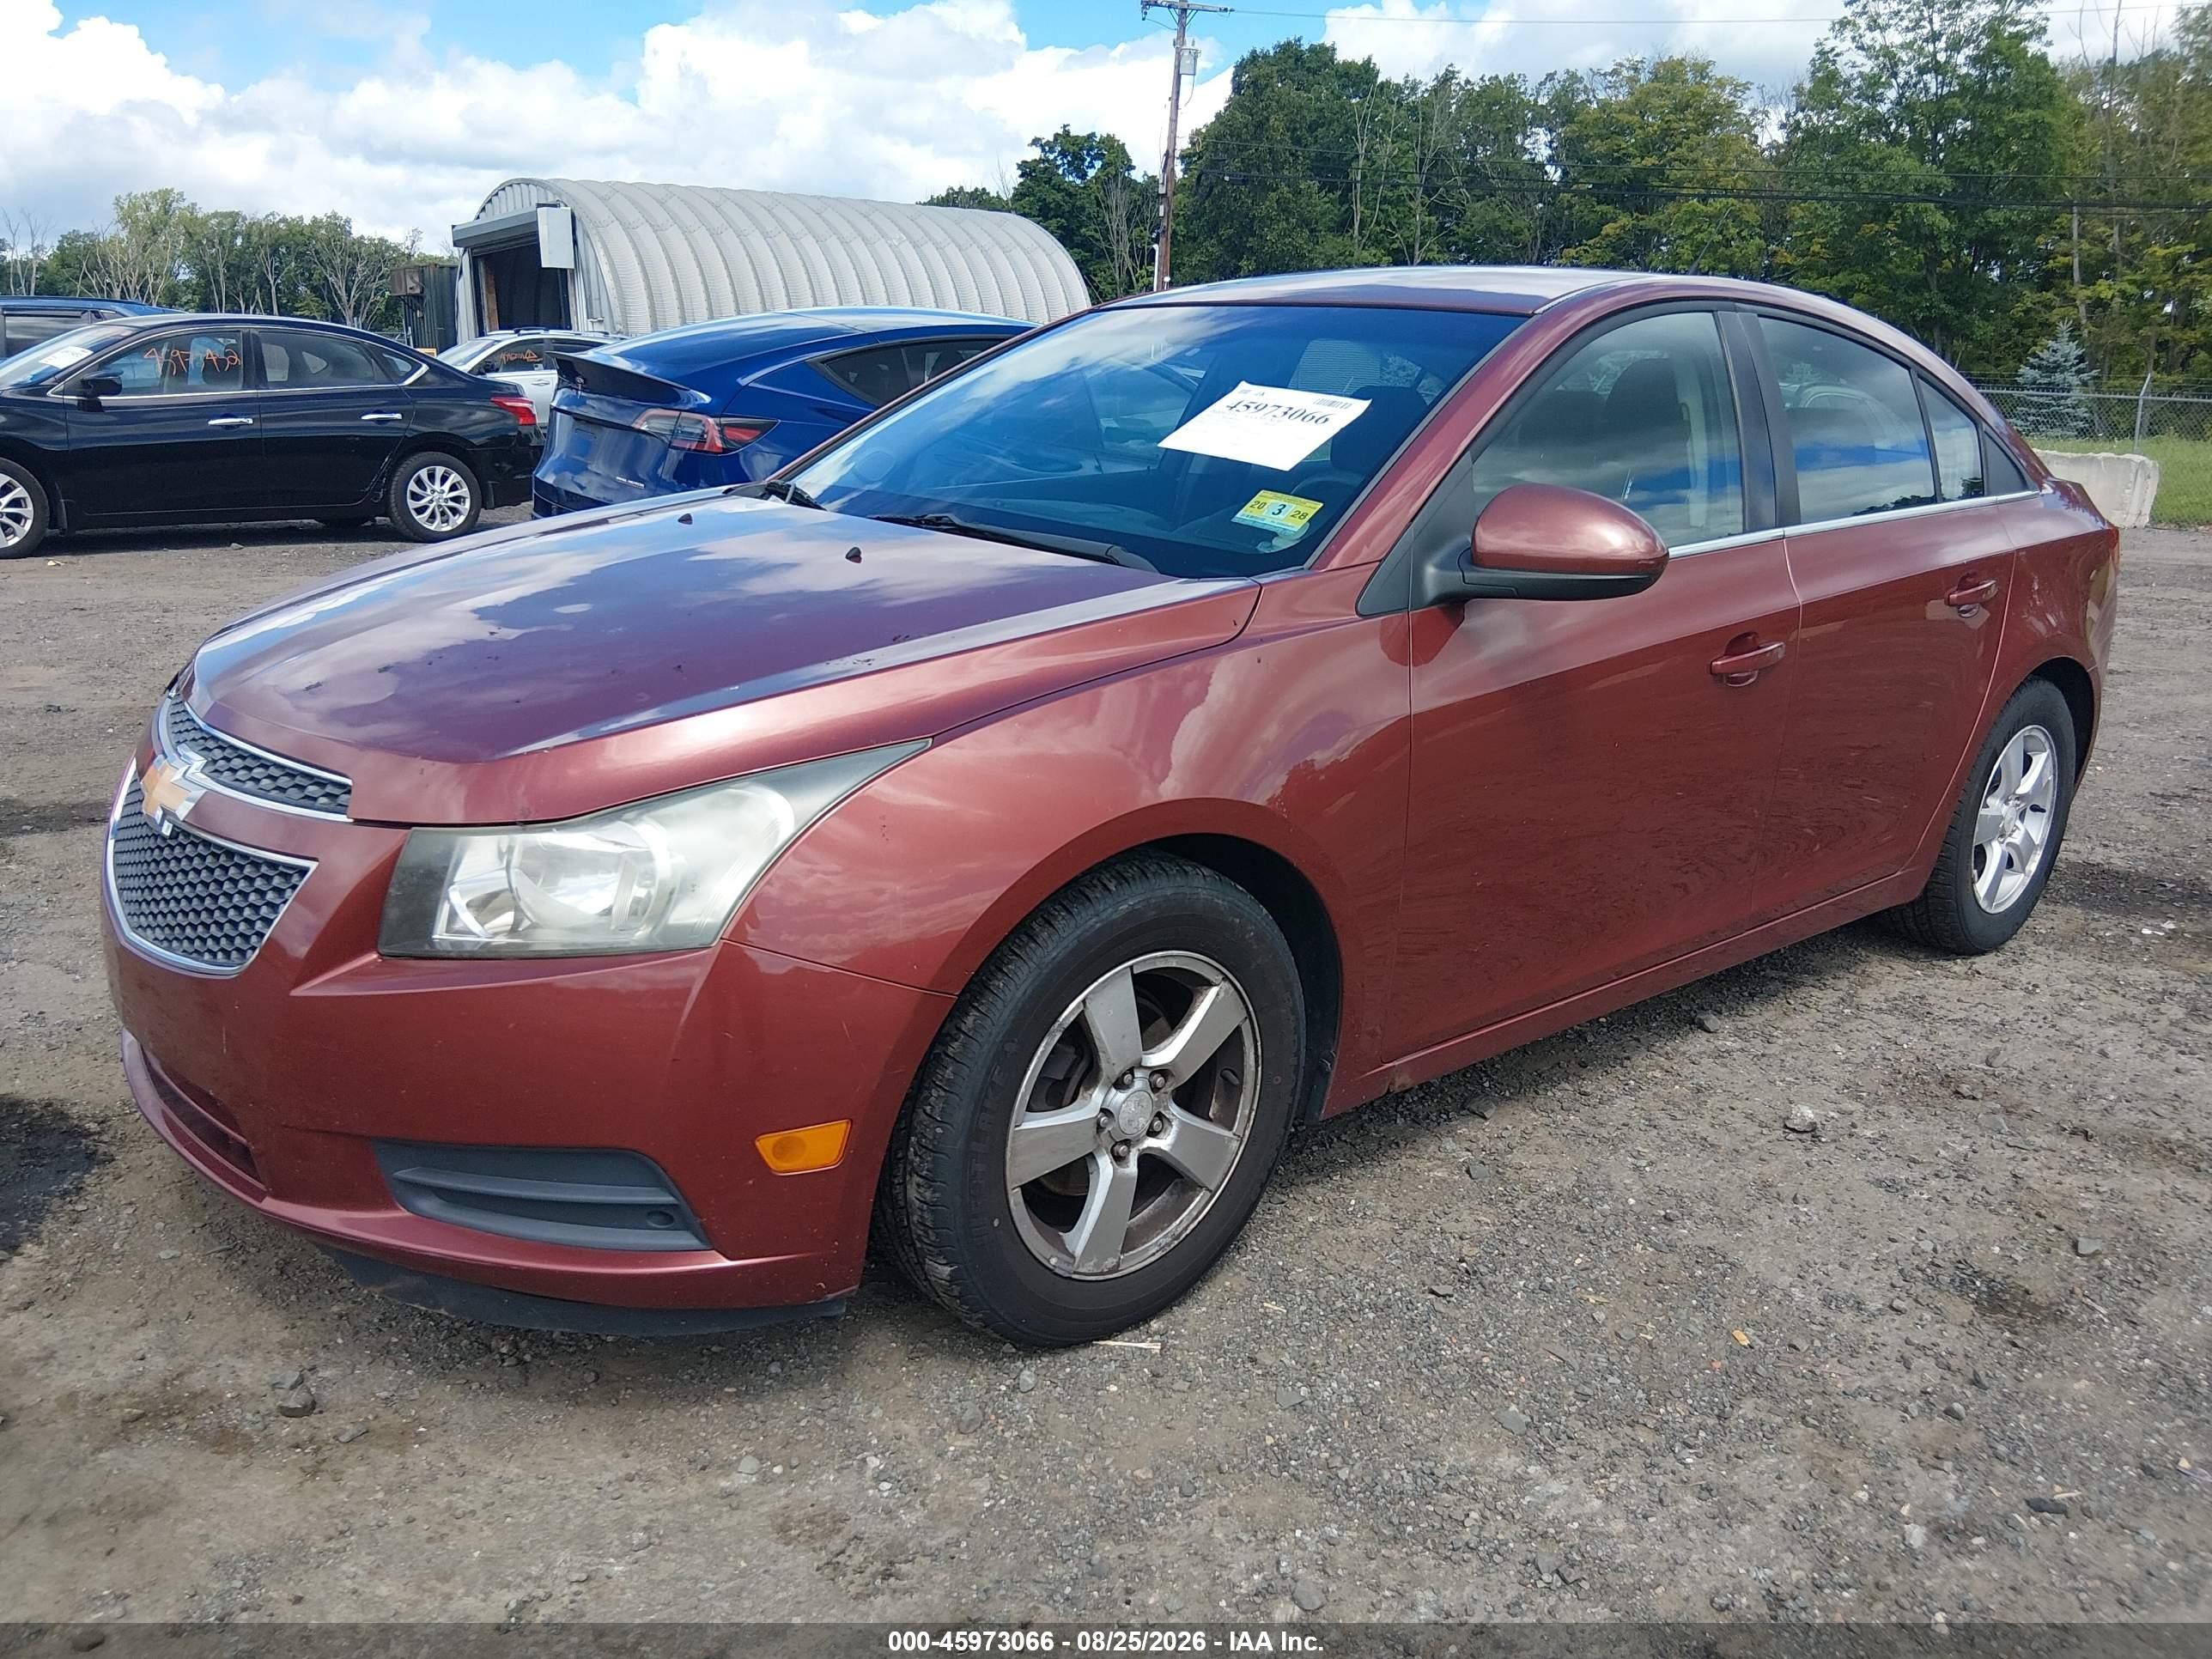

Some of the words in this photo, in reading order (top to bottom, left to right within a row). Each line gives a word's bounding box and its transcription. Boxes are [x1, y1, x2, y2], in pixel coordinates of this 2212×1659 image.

[1225, 399, 1333, 425] 45973066
[1249, 501, 1267, 510] 20
[1272, 503, 1286, 516] 3
[1291, 510, 1309, 520] 28
